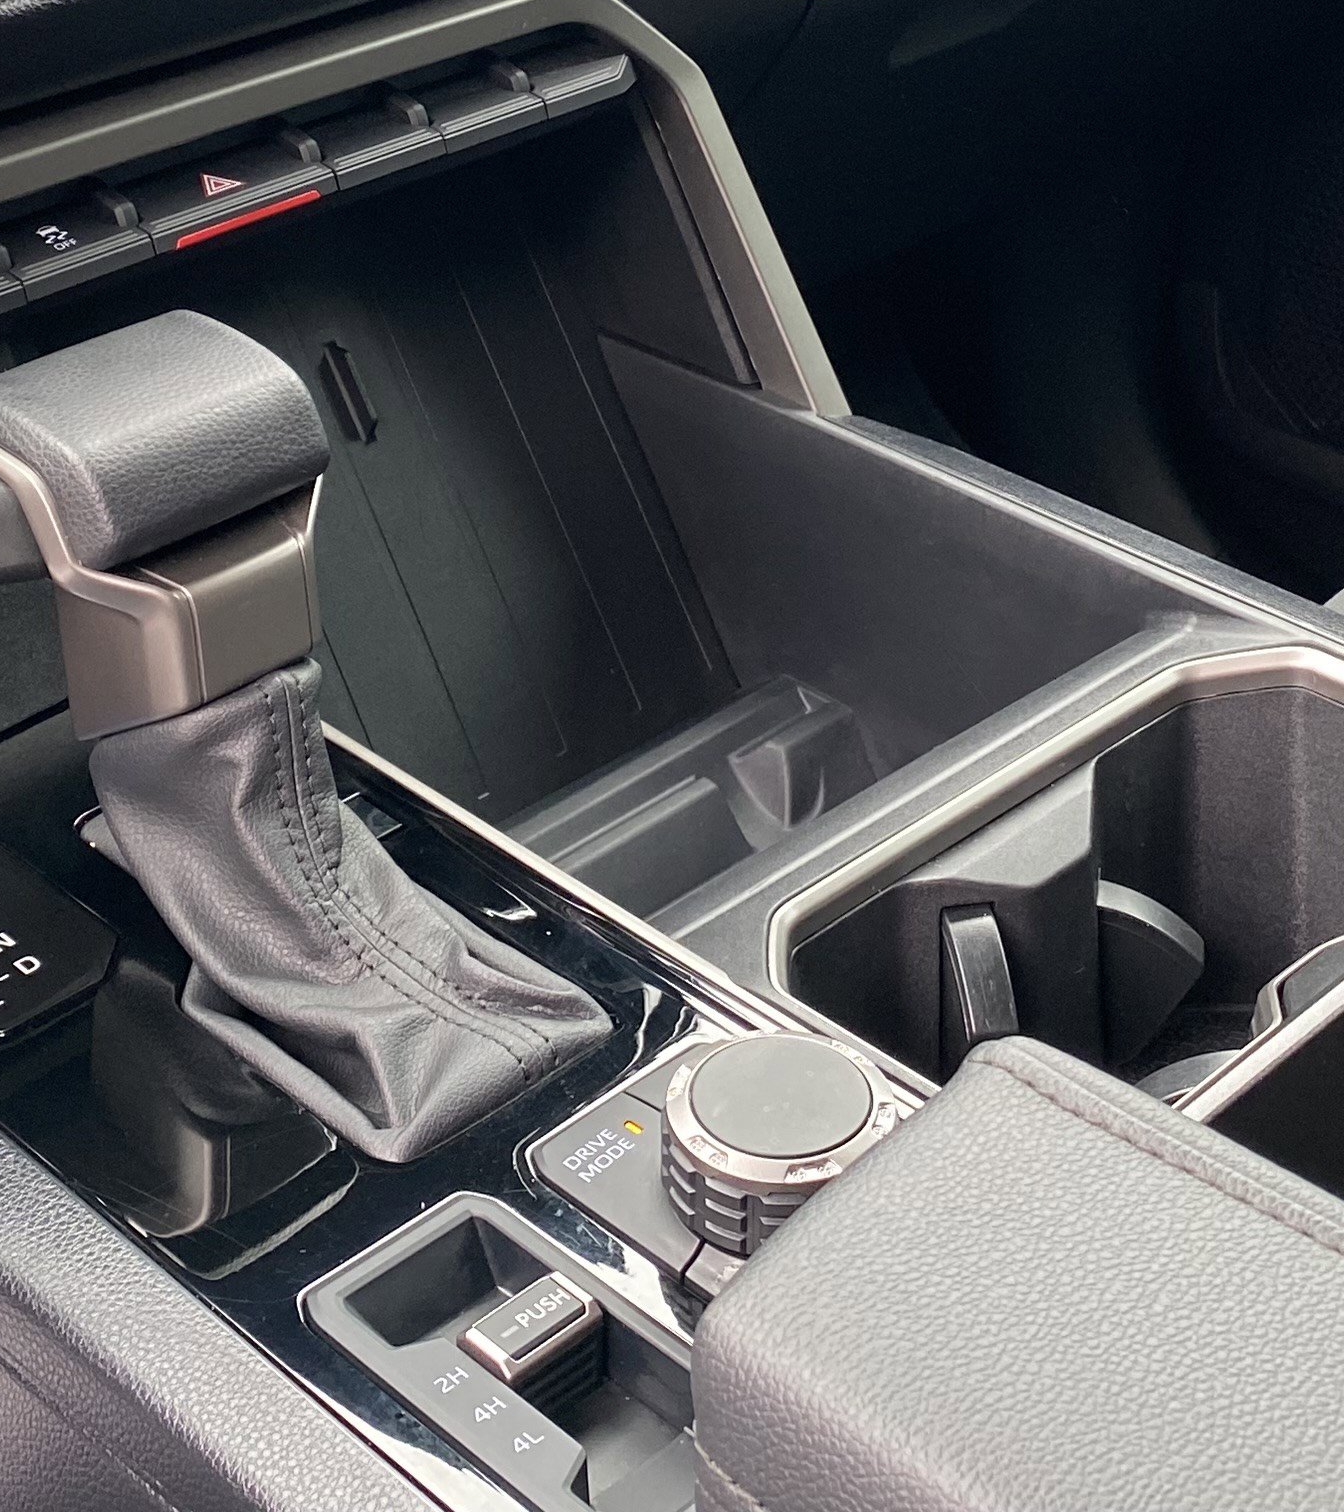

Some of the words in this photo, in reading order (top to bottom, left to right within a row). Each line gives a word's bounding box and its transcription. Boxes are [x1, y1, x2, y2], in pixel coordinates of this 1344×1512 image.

[53, 238, 76, 251] OFF
[13, 955, 41, 975] D
[562, 1128, 618, 1171] DRIVE
[577, 1137, 636, 1184] MODE
[514, 1287, 571, 1329] PUSH
[433, 1366, 470, 1394] 2H
[474, 1396, 507, 1423] 4H
[513, 1432, 545, 1454] 4L
